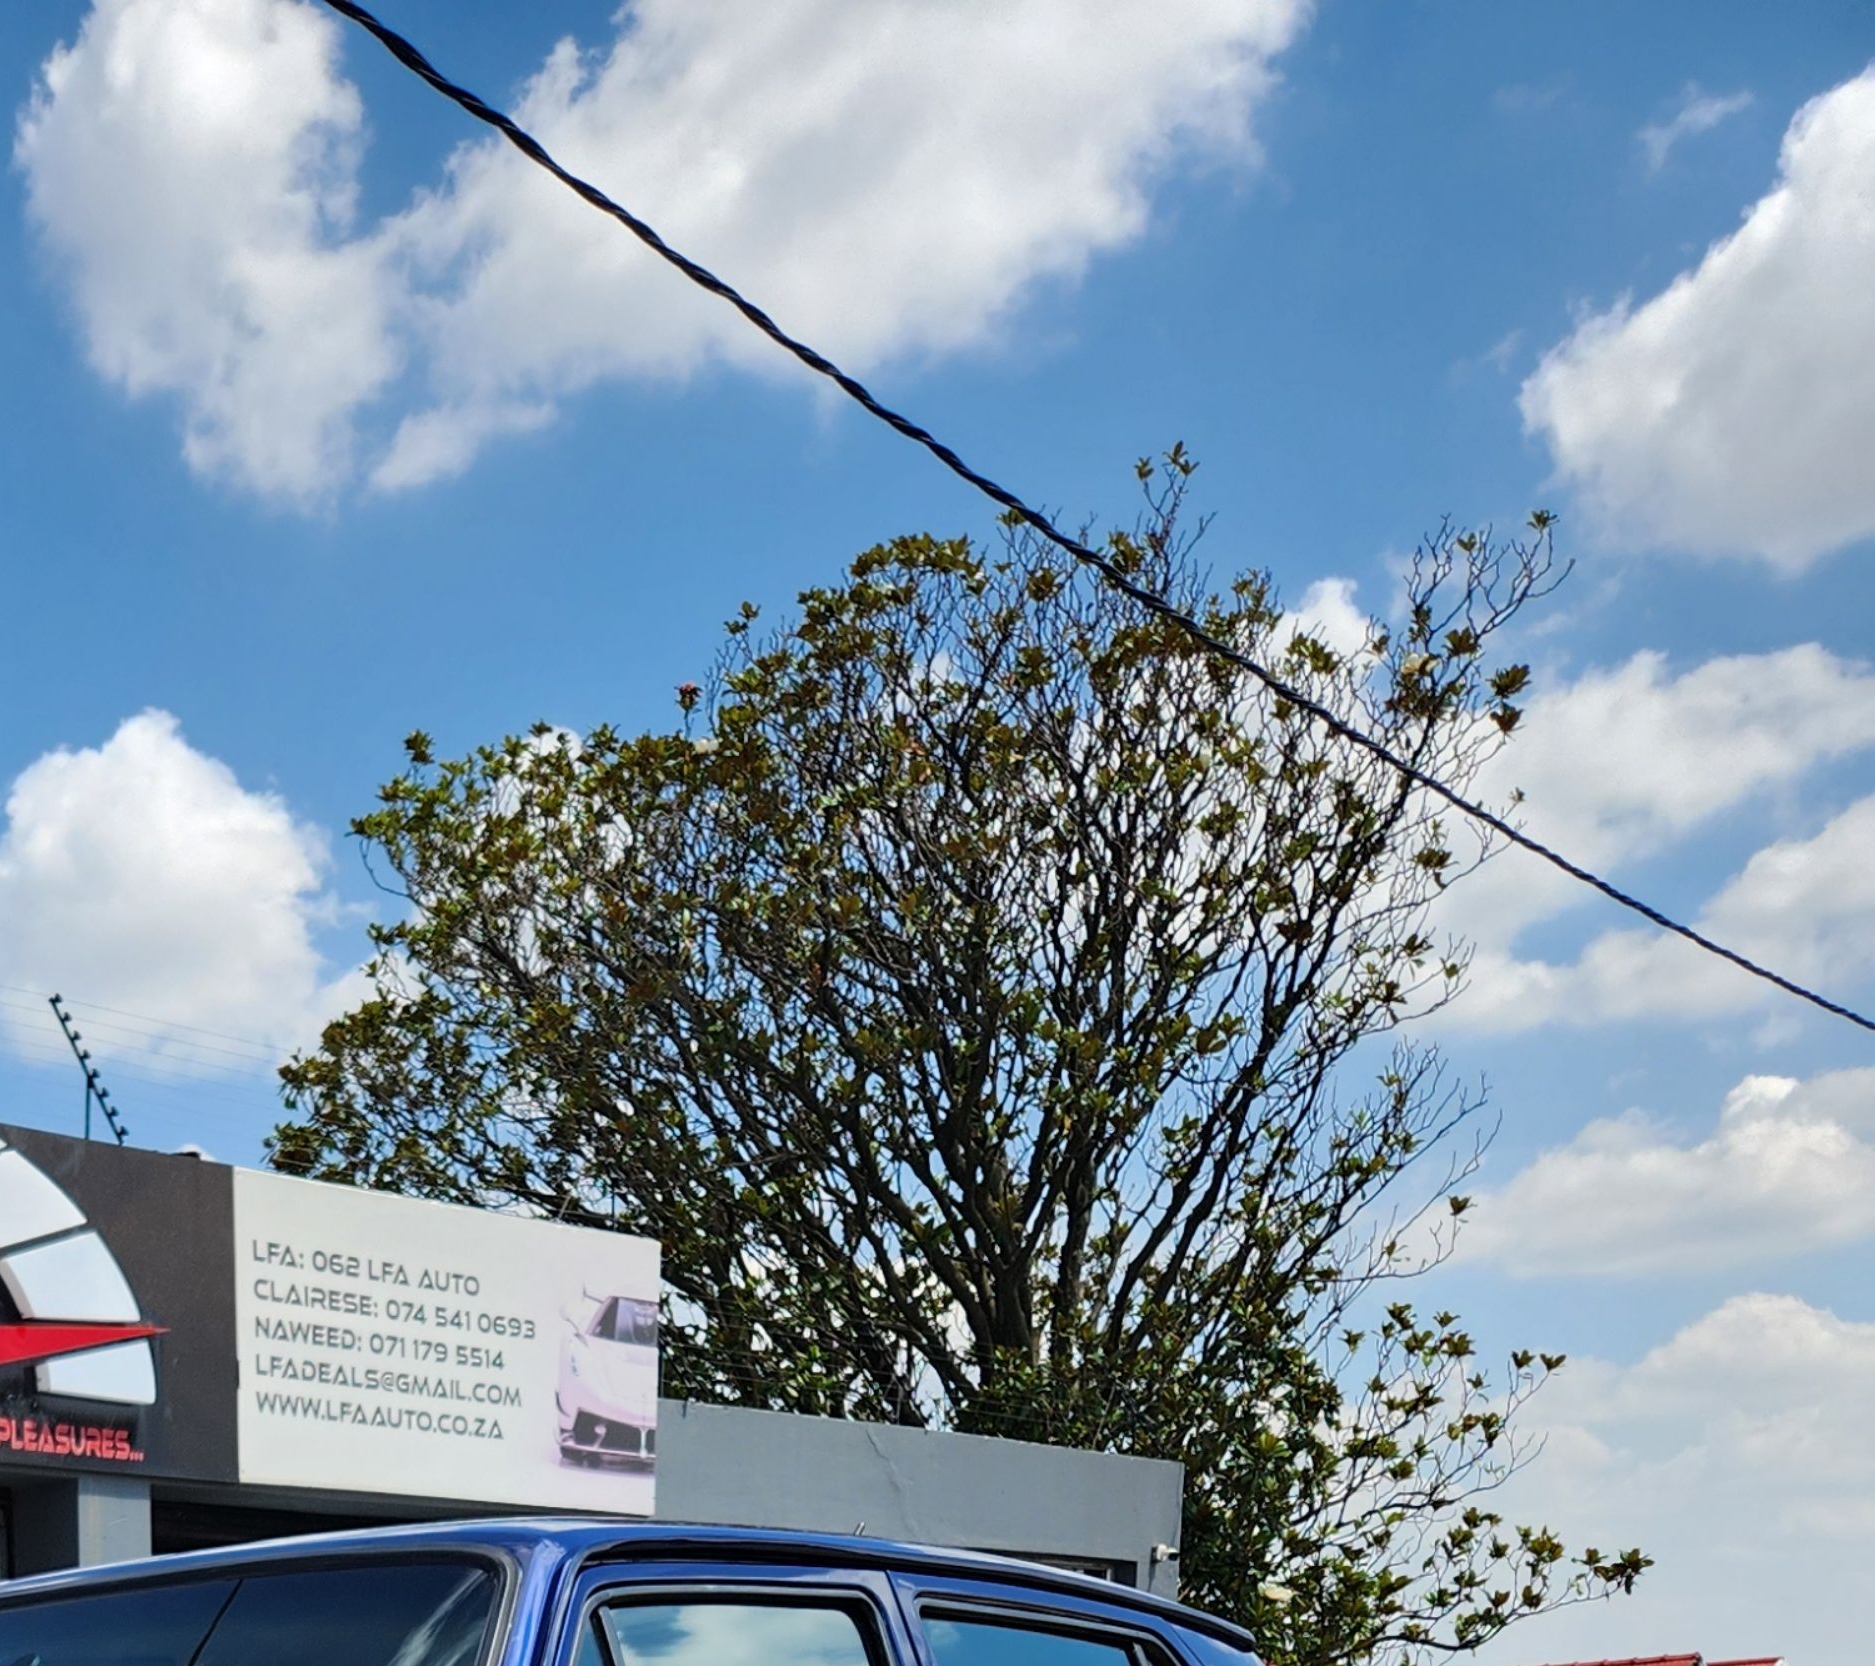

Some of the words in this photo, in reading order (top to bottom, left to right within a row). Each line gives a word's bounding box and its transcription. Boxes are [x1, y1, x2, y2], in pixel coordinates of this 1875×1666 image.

[252, 1239, 305, 1270] LFA:
[311, 1249, 361, 1279] 062
[367, 1258, 410, 1287] LFA
[417, 1268, 481, 1297] AUTO
[253, 1277, 379, 1319] CLAIRESE:
[385, 1299, 428, 1325] 074
[434, 1306, 471, 1332] 541
[477, 1313, 536, 1340] 0693
[254, 1315, 362, 1353] NAWEED:
[369, 1333, 406, 1359] 071
[412, 1338, 449, 1363] 179
[455, 1344, 505, 1371] 5514
[255, 1353, 523, 1408] LFADEALS@GMAIL.COM
[255, 1390, 505, 1440] WWW.LFAAUTO.CO.ZA
